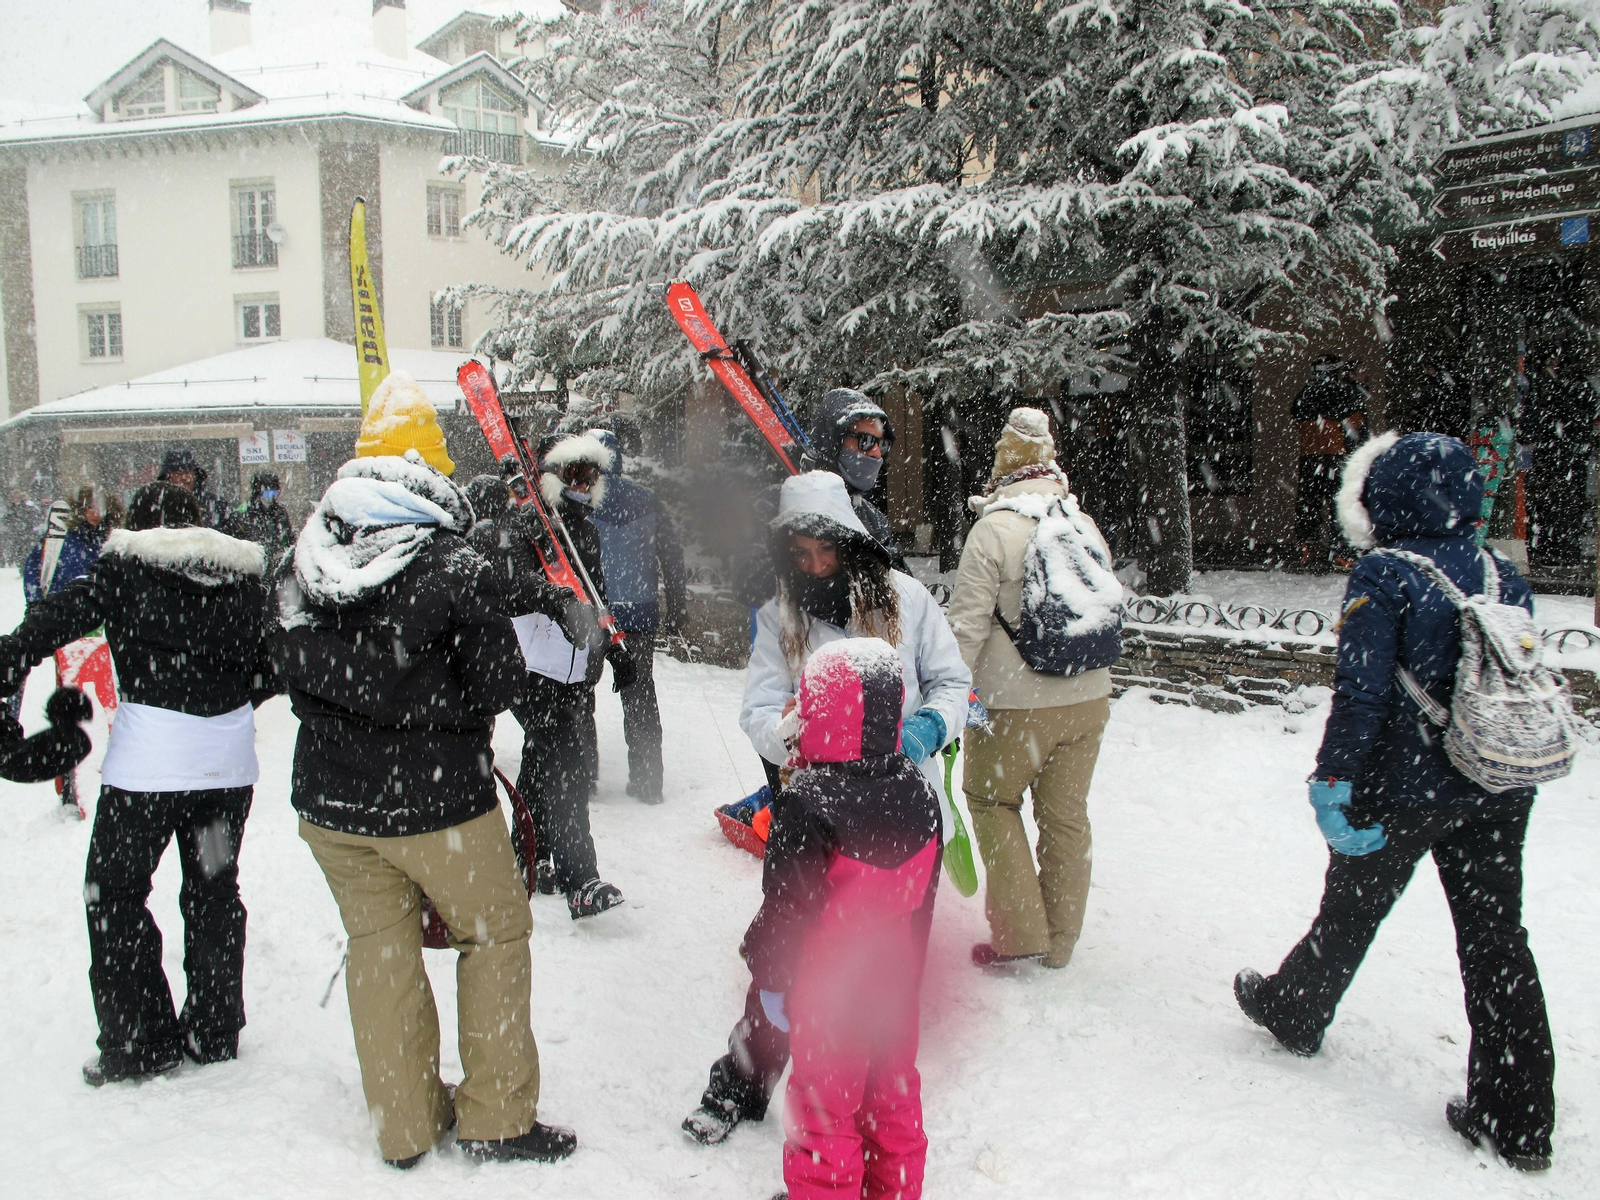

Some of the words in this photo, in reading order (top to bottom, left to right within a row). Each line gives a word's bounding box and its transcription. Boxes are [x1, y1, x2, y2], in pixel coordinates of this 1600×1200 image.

[1537, 143, 1559, 155] Bus
[1460, 194, 1495, 206] Plaza
[1502, 183, 1575, 201] Pradollano
[1471, 231, 1537, 250] Taquillas
